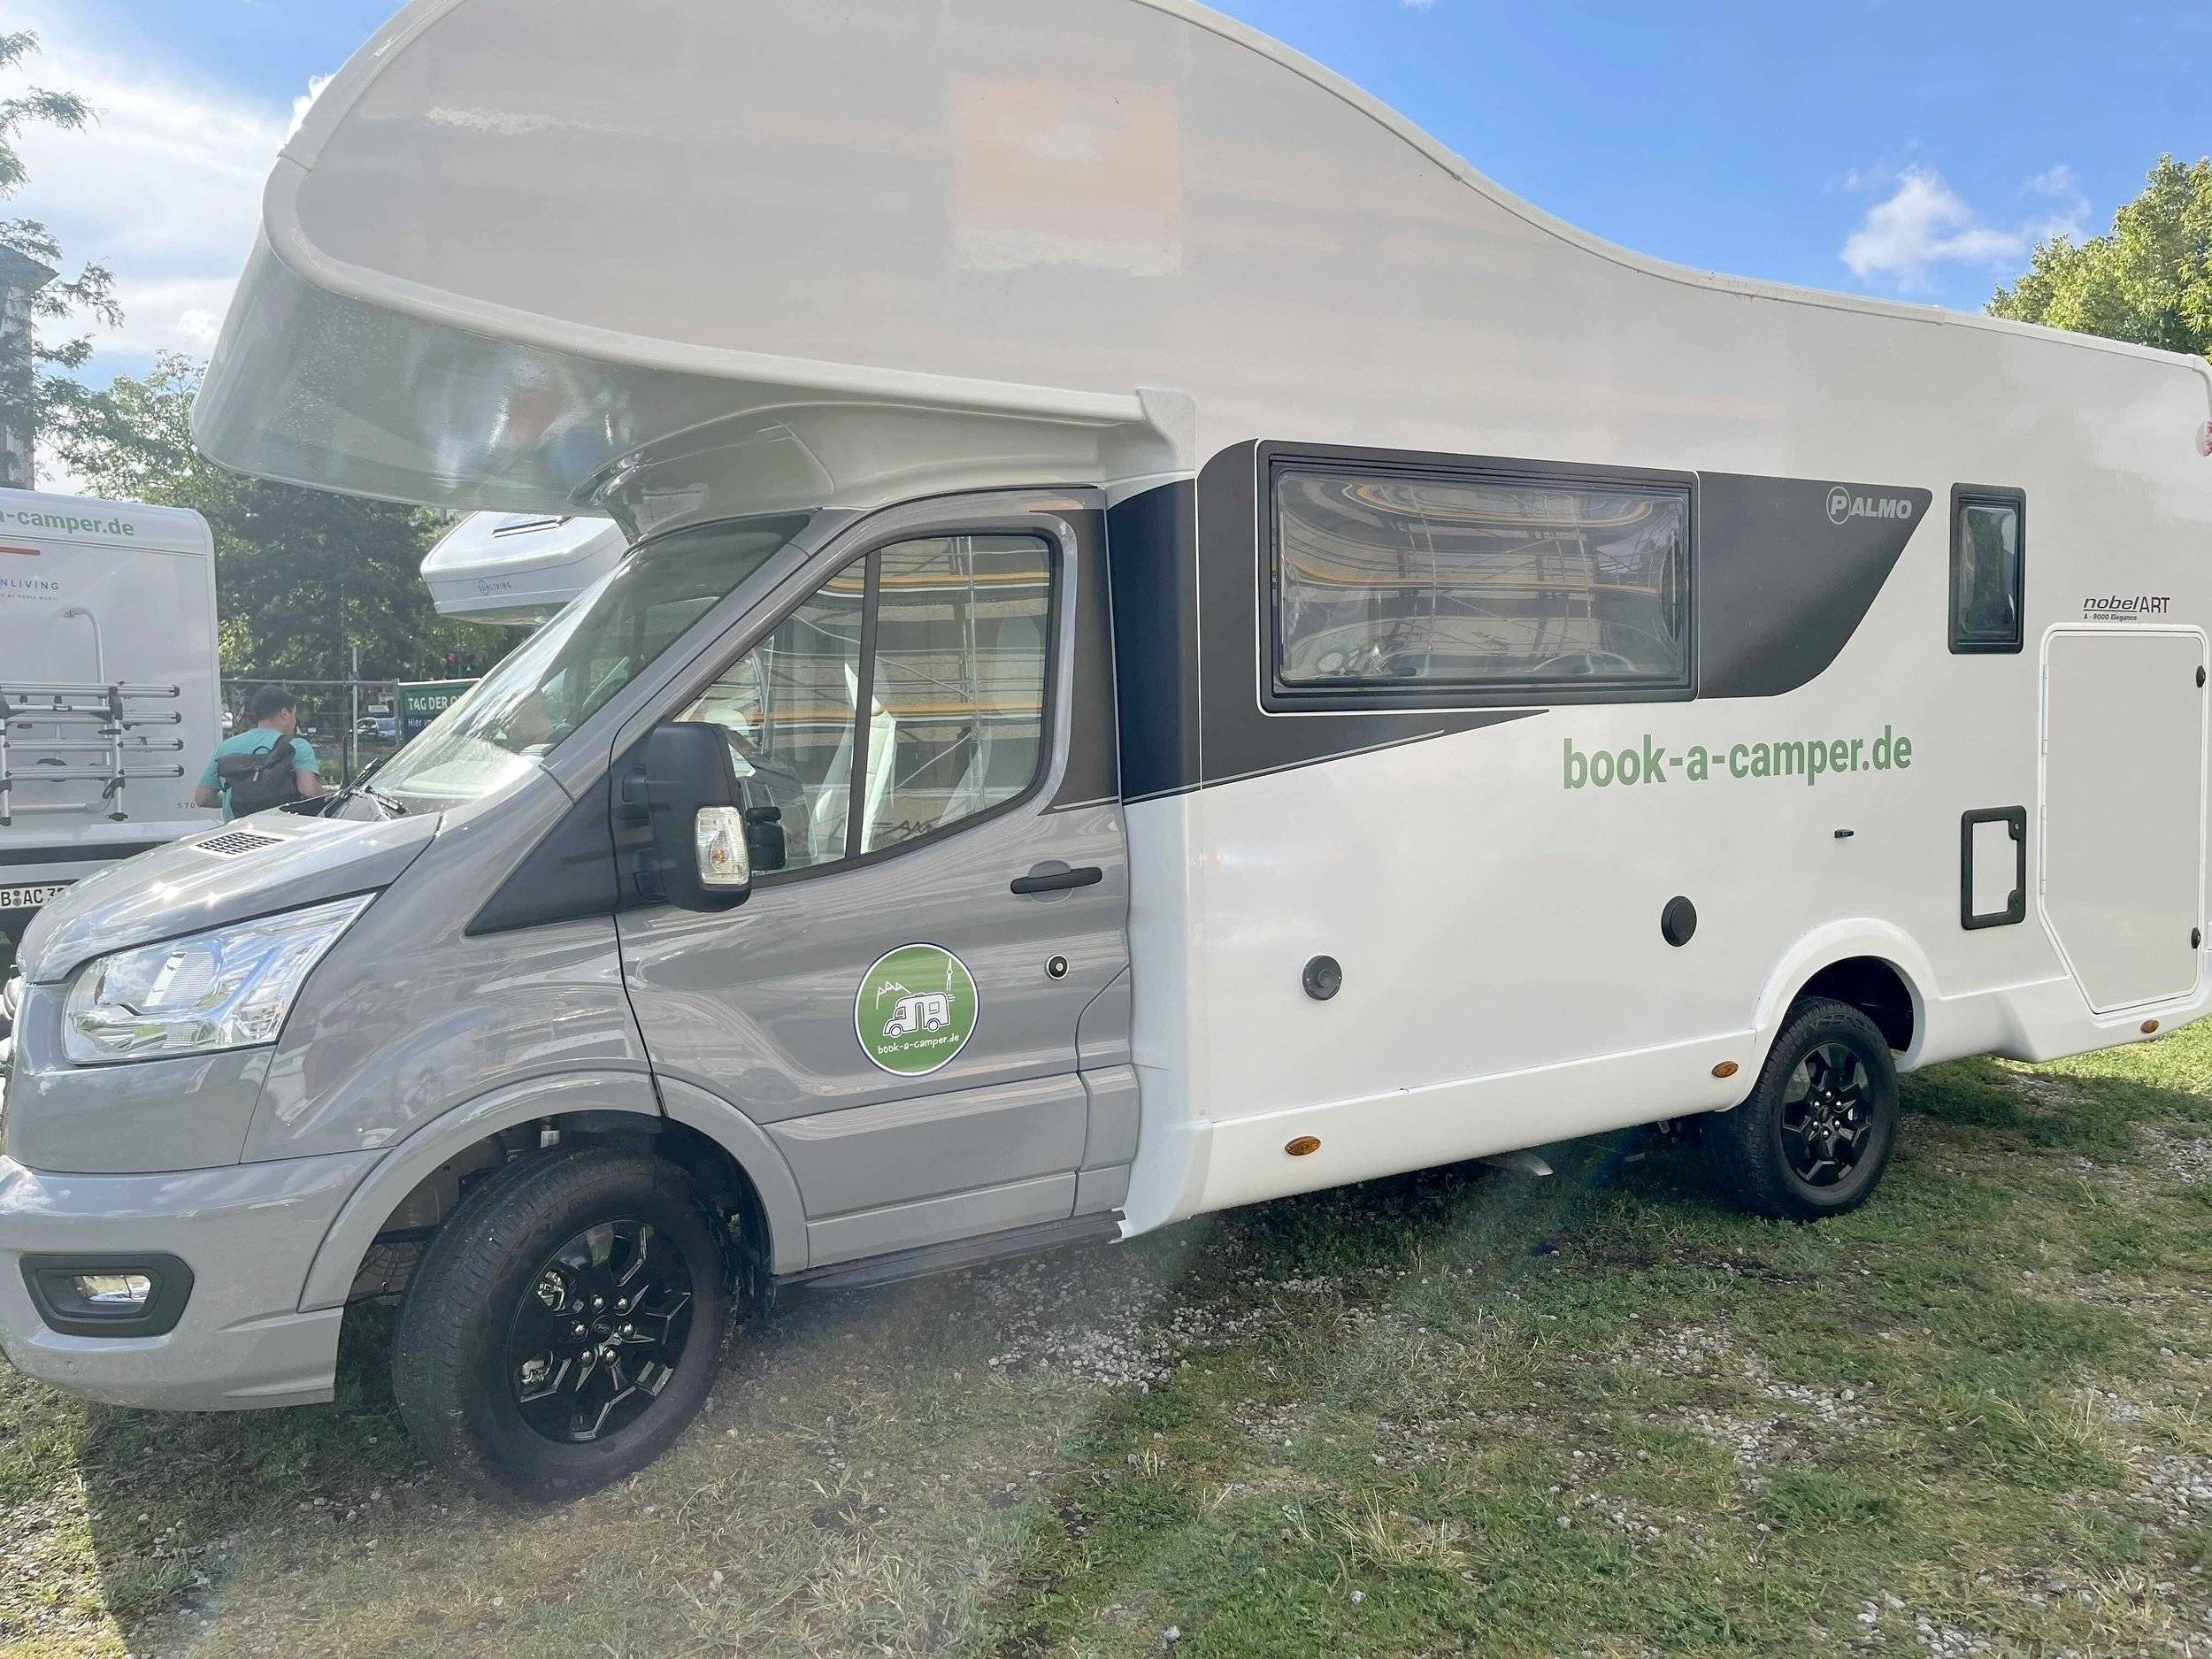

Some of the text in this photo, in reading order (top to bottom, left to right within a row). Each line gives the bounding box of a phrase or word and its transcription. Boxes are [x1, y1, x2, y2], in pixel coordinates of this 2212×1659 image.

[1829, 494, 1912, 519] PALMO
[2083, 595, 2170, 613] nobelART
[2110, 613, 2138, 622] Elegance
[408, 697, 427, 710] TAG
[428, 695, 449, 710] DER
[1563, 724, 1912, 790] book-a-camper.de
[1, 891, 12, 907] B
[23, 888, 43, 904] AC
[877, 1033, 960, 1055] book-a-camper.de
